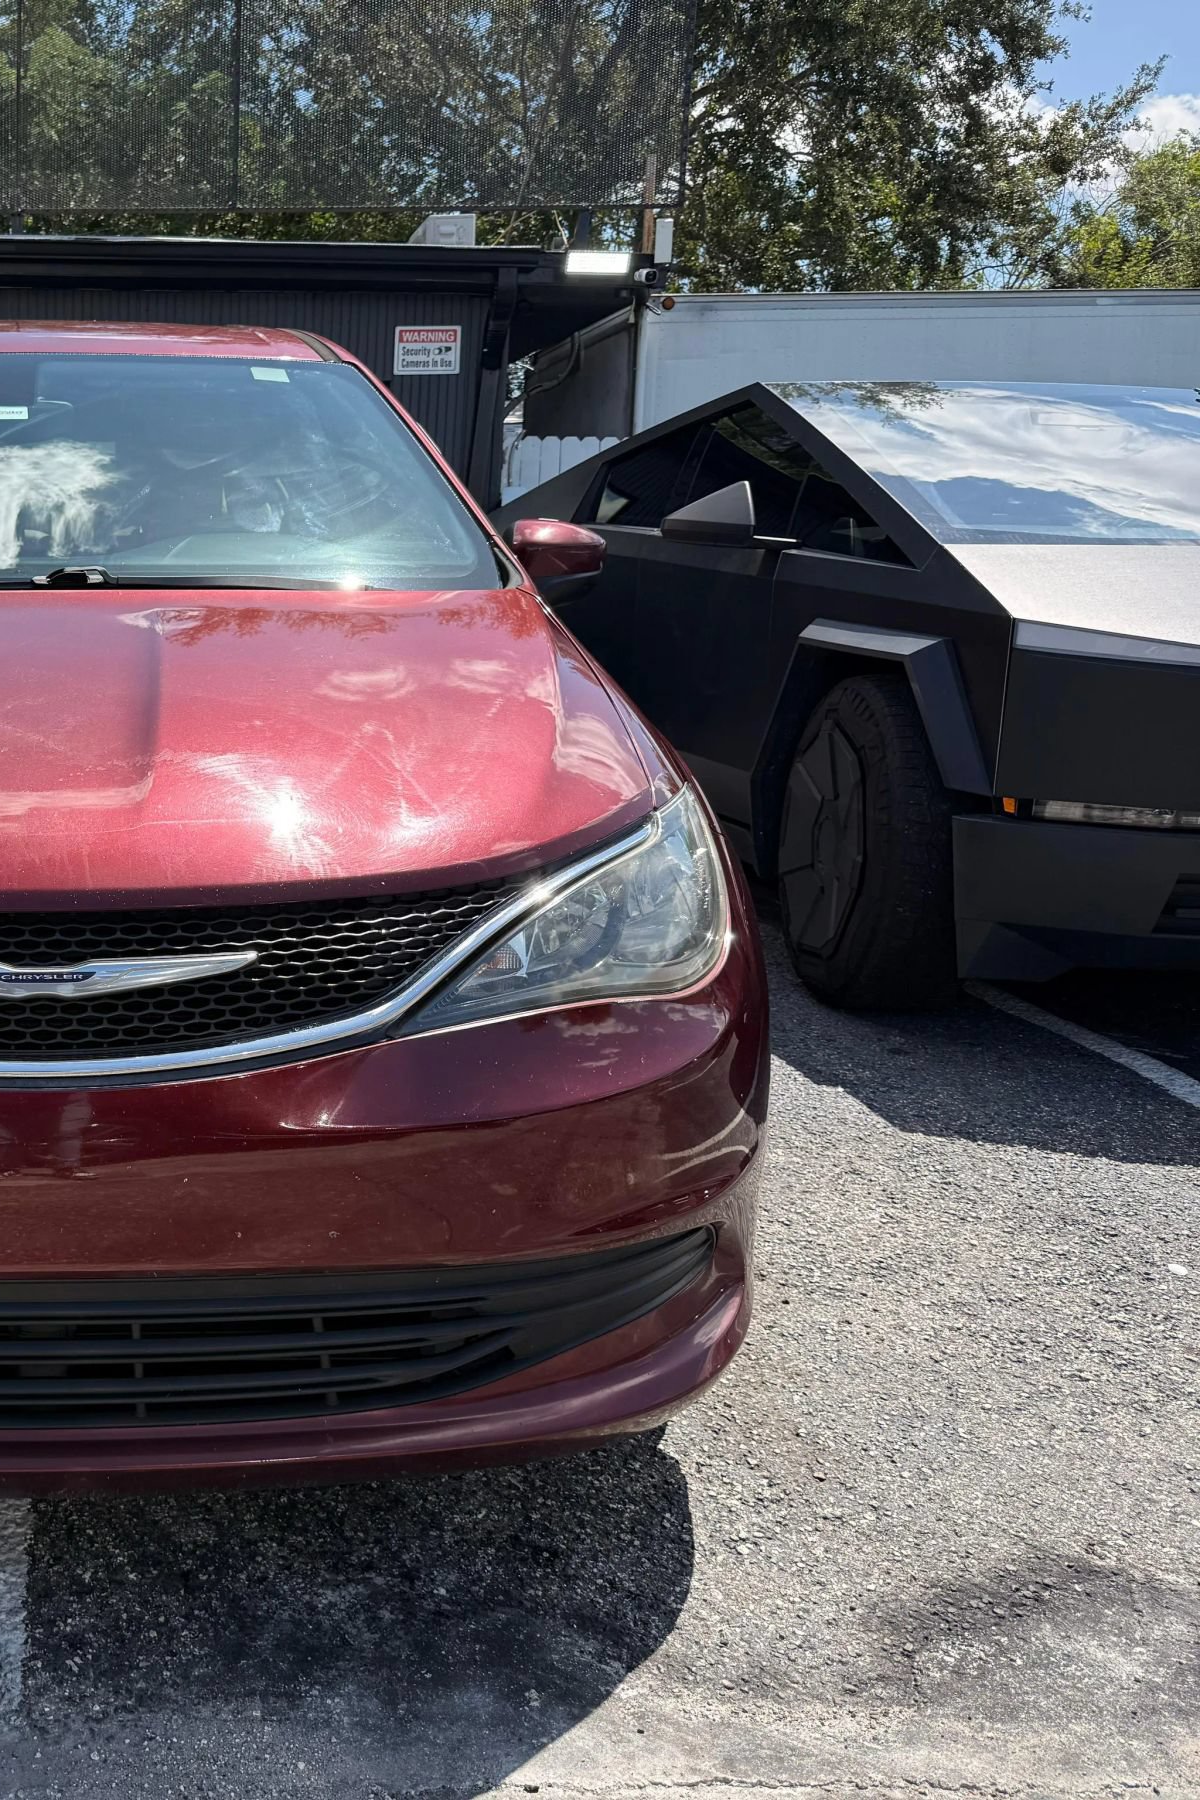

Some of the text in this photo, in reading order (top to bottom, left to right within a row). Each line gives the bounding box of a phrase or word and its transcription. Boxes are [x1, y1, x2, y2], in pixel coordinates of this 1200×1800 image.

[402, 331, 455, 342] WARNING
[401, 345, 431, 358] Security
[401, 358, 452, 369] Cameras In Use
